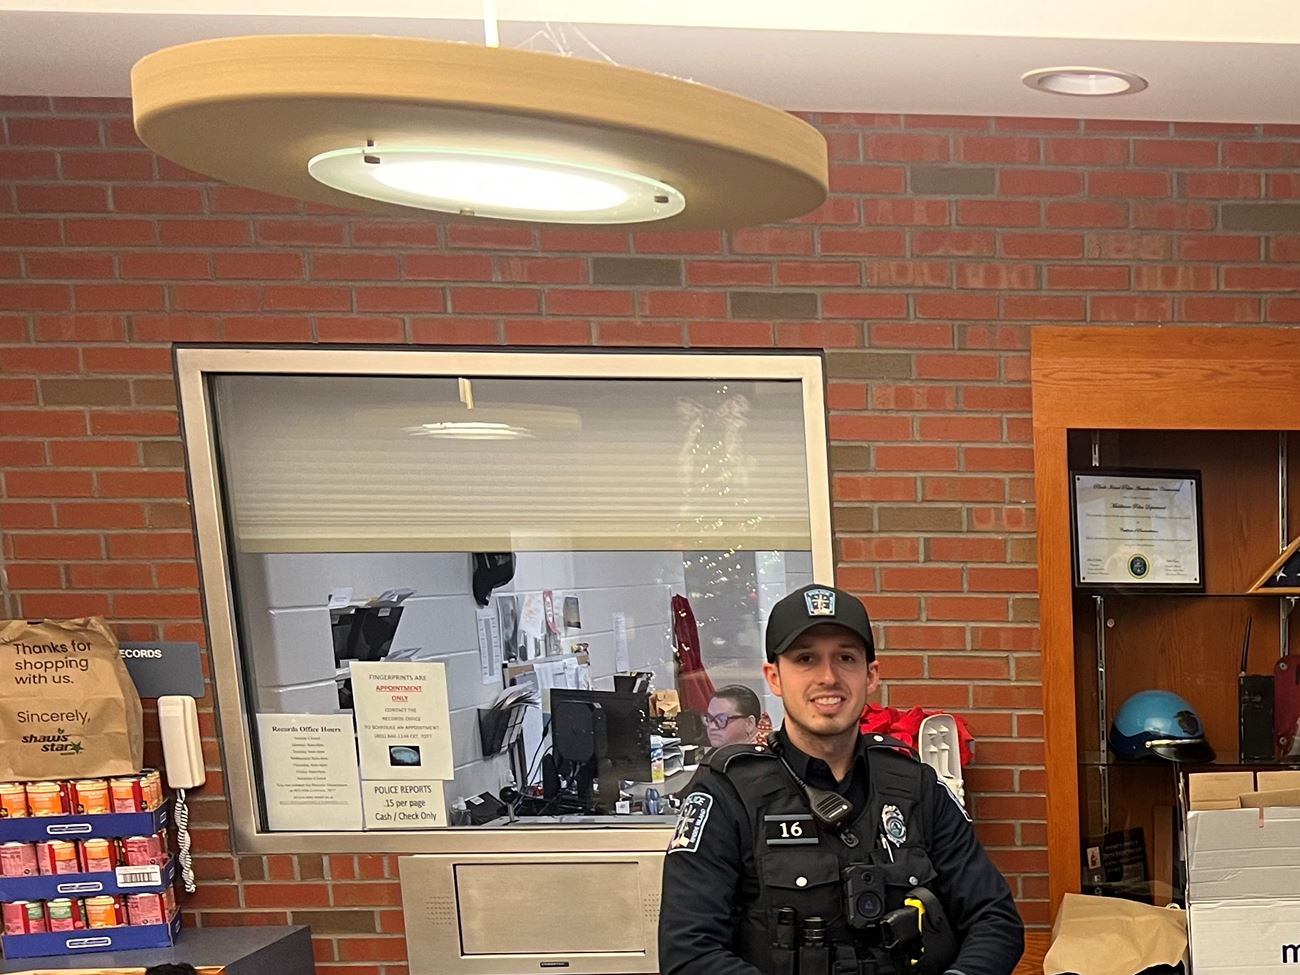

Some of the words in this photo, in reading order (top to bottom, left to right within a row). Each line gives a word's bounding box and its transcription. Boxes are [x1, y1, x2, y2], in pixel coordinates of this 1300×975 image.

[14, 641, 68, 655] Thanks
[71, 640, 92, 653] for
[119, 649, 162, 658] ECORDS
[15, 657, 89, 672] shopping
[15, 673, 48, 685] with
[52, 674, 74, 685] us.
[17, 709, 91, 725] Sincerely,
[374, 786, 398, 794] POLICE
[400, 785, 432, 794] REPORTS
[396, 800, 407, 808] per
[410, 800, 426, 808] page
[375, 812, 392, 821] Cash
[398, 812, 420, 820] Check
[420, 812, 437, 822] Only
[779, 822, 803, 838] 16
